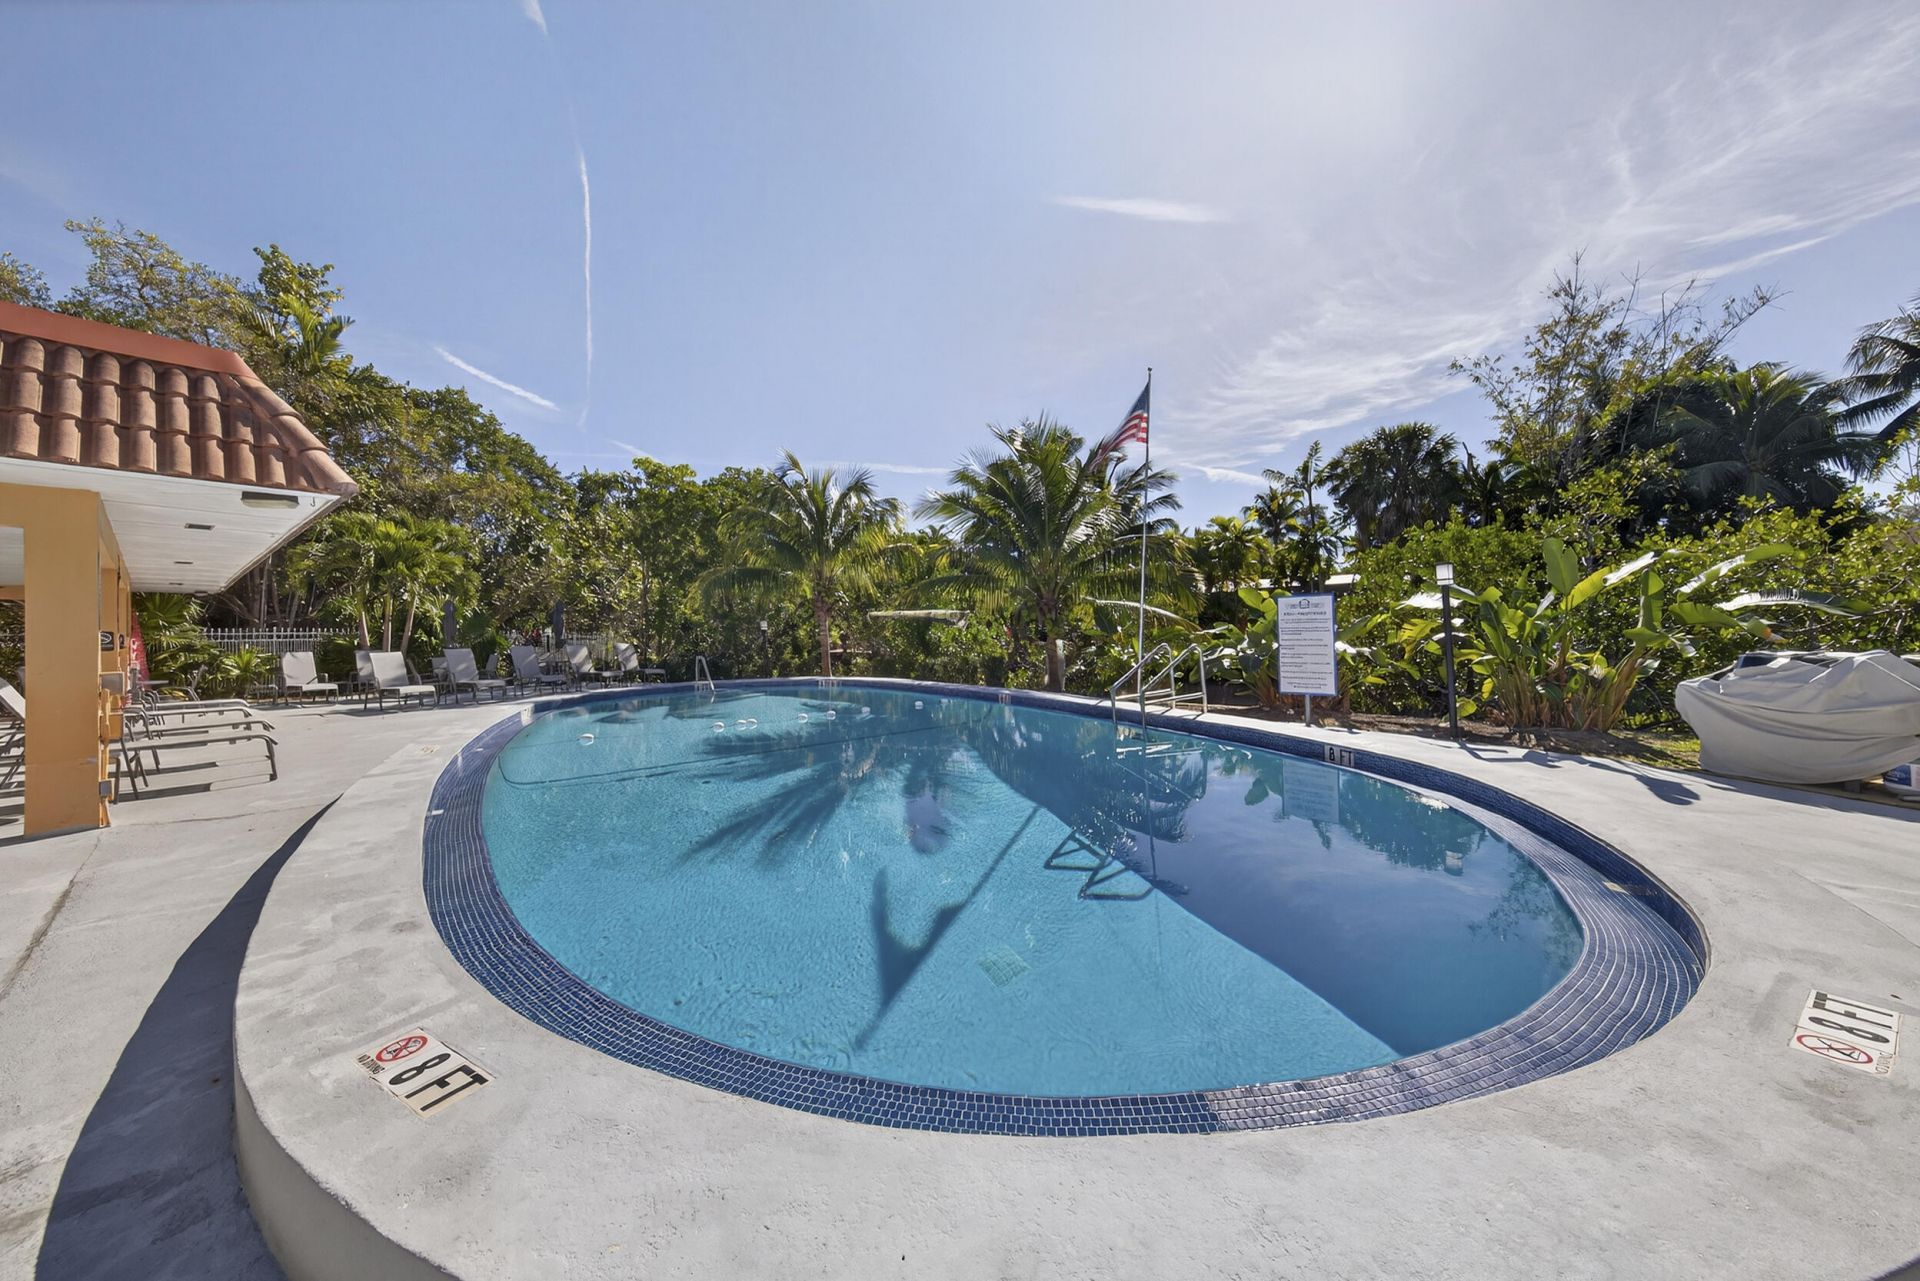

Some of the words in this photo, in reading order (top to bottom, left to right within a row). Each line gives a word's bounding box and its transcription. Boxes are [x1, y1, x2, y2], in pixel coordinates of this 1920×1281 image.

[1329, 746, 1335, 761] 8
[1340, 748, 1352, 767] FT
[1812, 991, 1893, 1029] FT
[1808, 1016, 1890, 1043] 8
[388, 1053, 451, 1085] 8
[404, 1064, 489, 1112] FT
